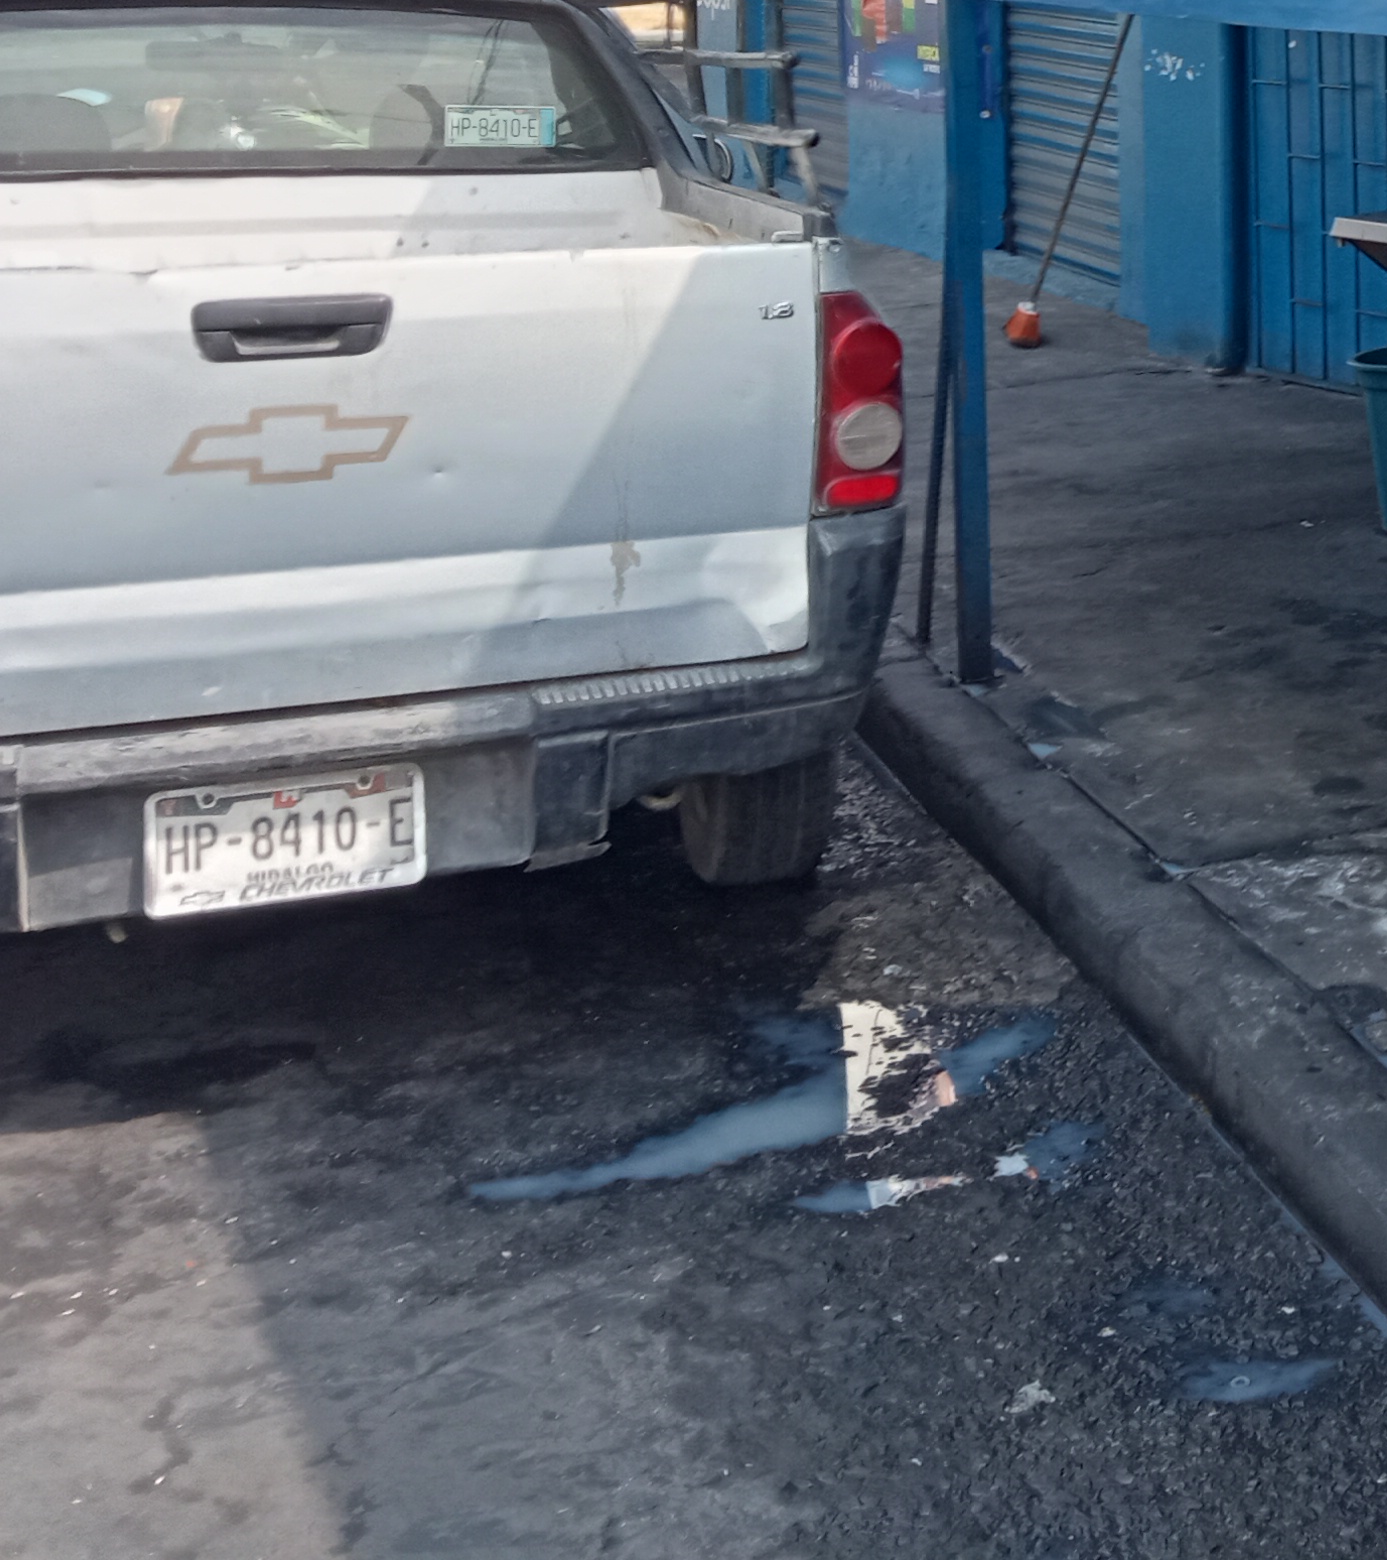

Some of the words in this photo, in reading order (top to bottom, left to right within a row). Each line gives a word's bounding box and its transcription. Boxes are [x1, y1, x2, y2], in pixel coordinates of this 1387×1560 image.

[450, 117, 539, 138] HP-8410-E
[758, 300, 795, 320] 1.8
[164, 796, 415, 875] HP-8410-E
[239, 867, 396, 902] CHEVROLET
